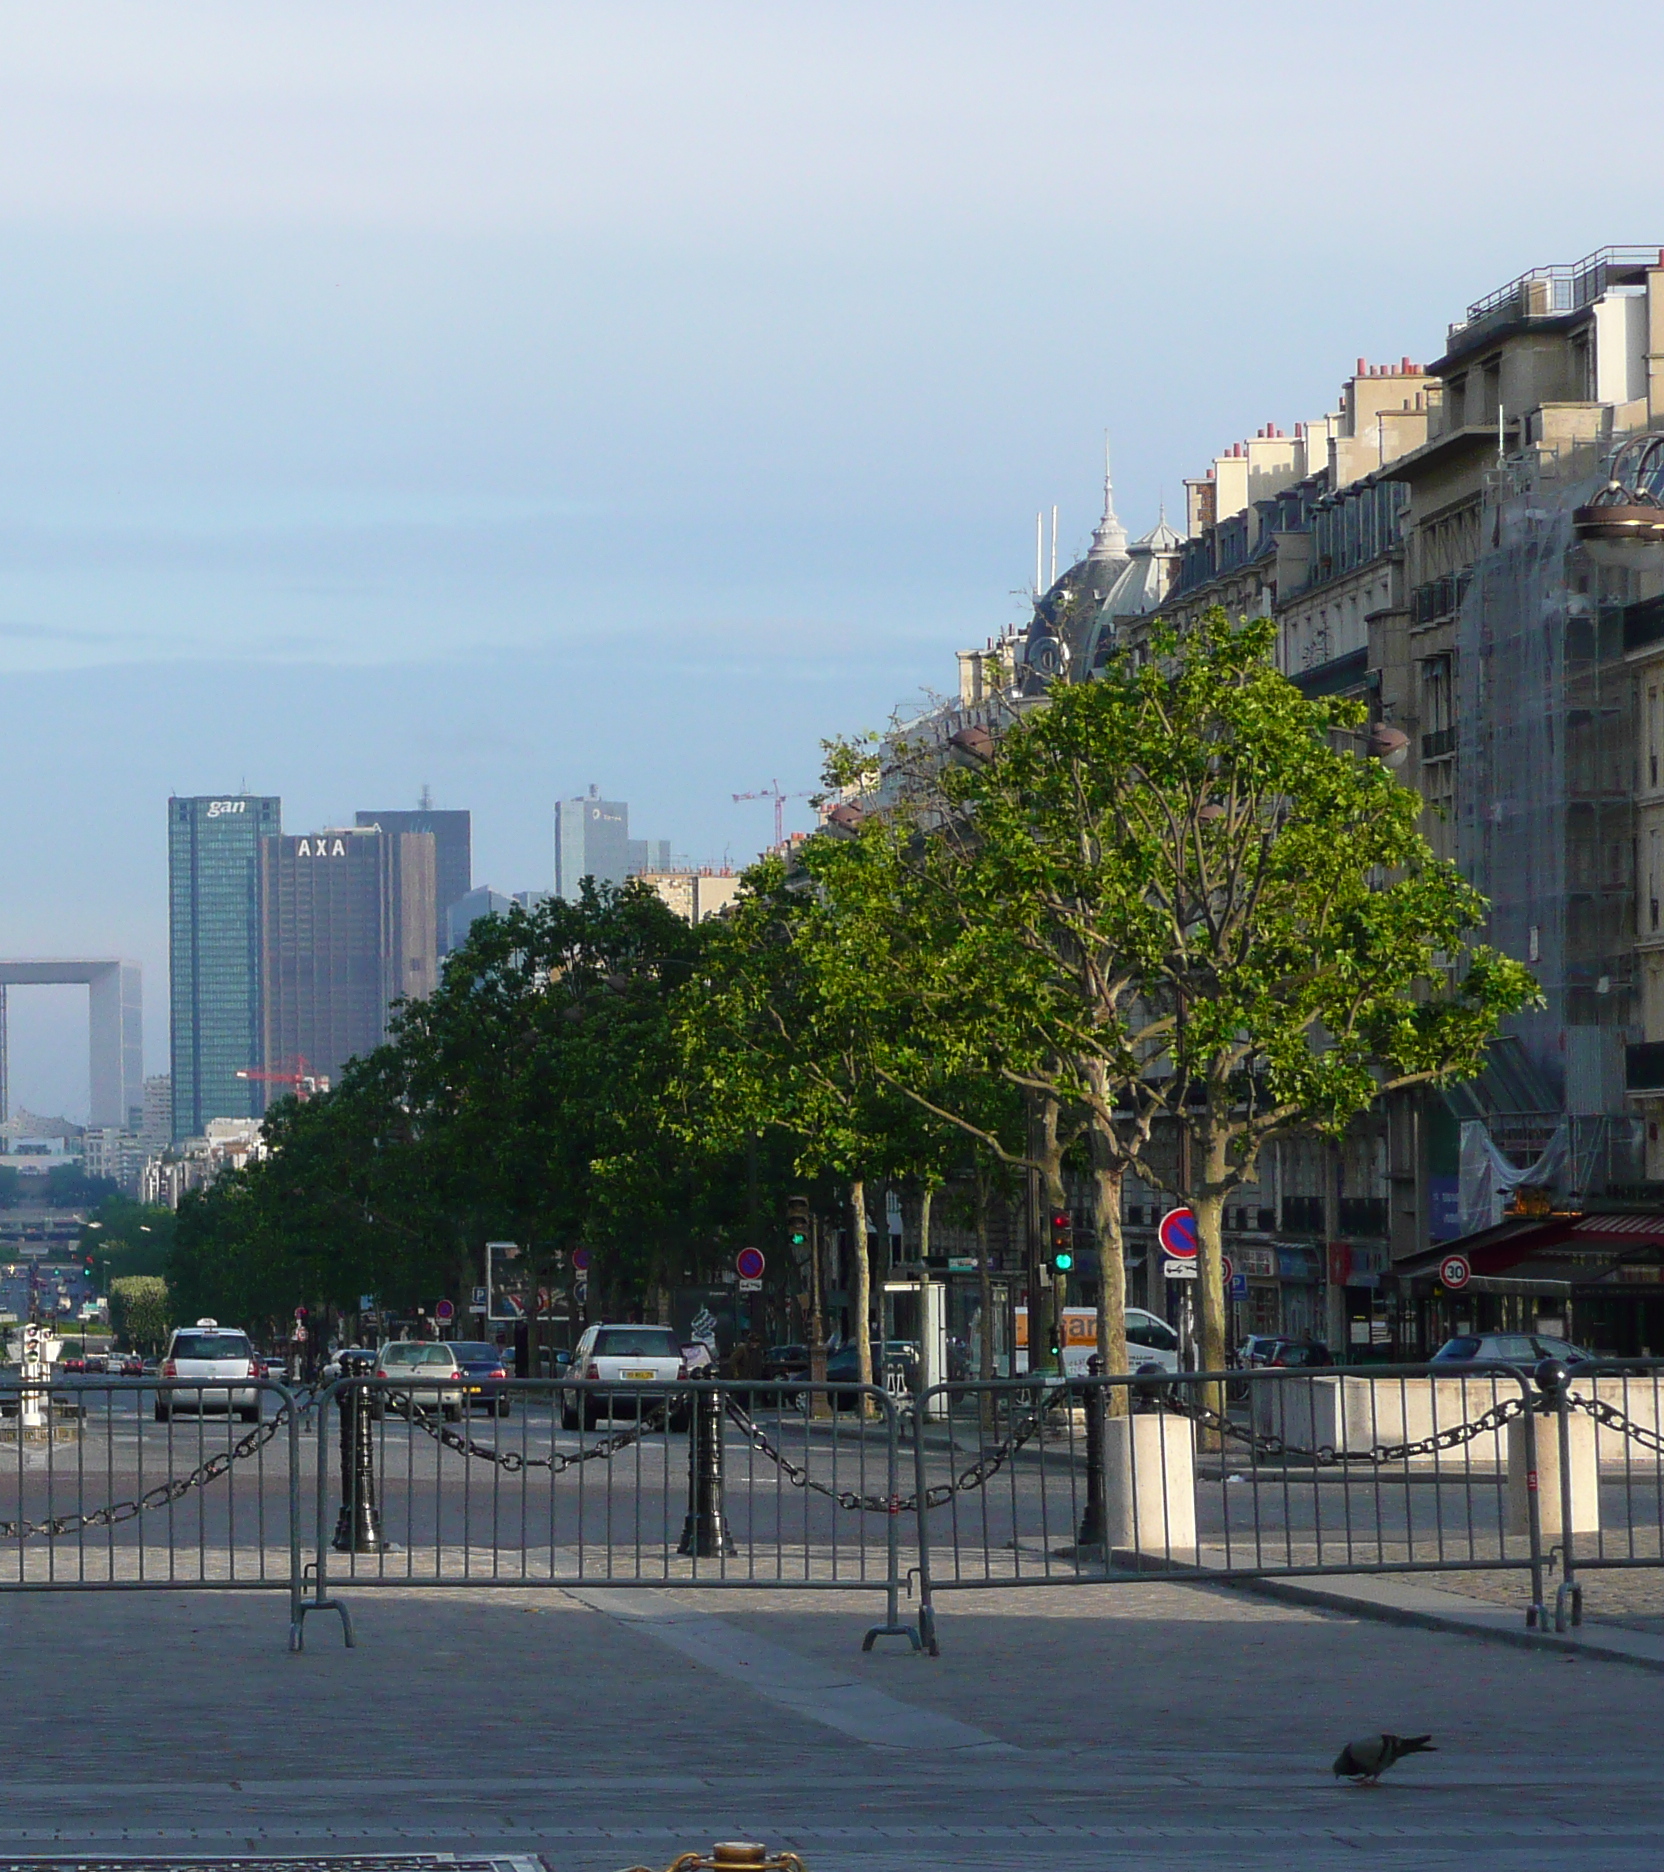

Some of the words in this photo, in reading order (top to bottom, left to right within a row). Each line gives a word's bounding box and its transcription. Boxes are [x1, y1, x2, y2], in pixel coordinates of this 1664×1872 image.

[207, 800, 245, 818] gan
[298, 839, 345, 857] AXA
[1447, 1265, 1464, 1279] 30
[476, 1289, 484, 1299] P
